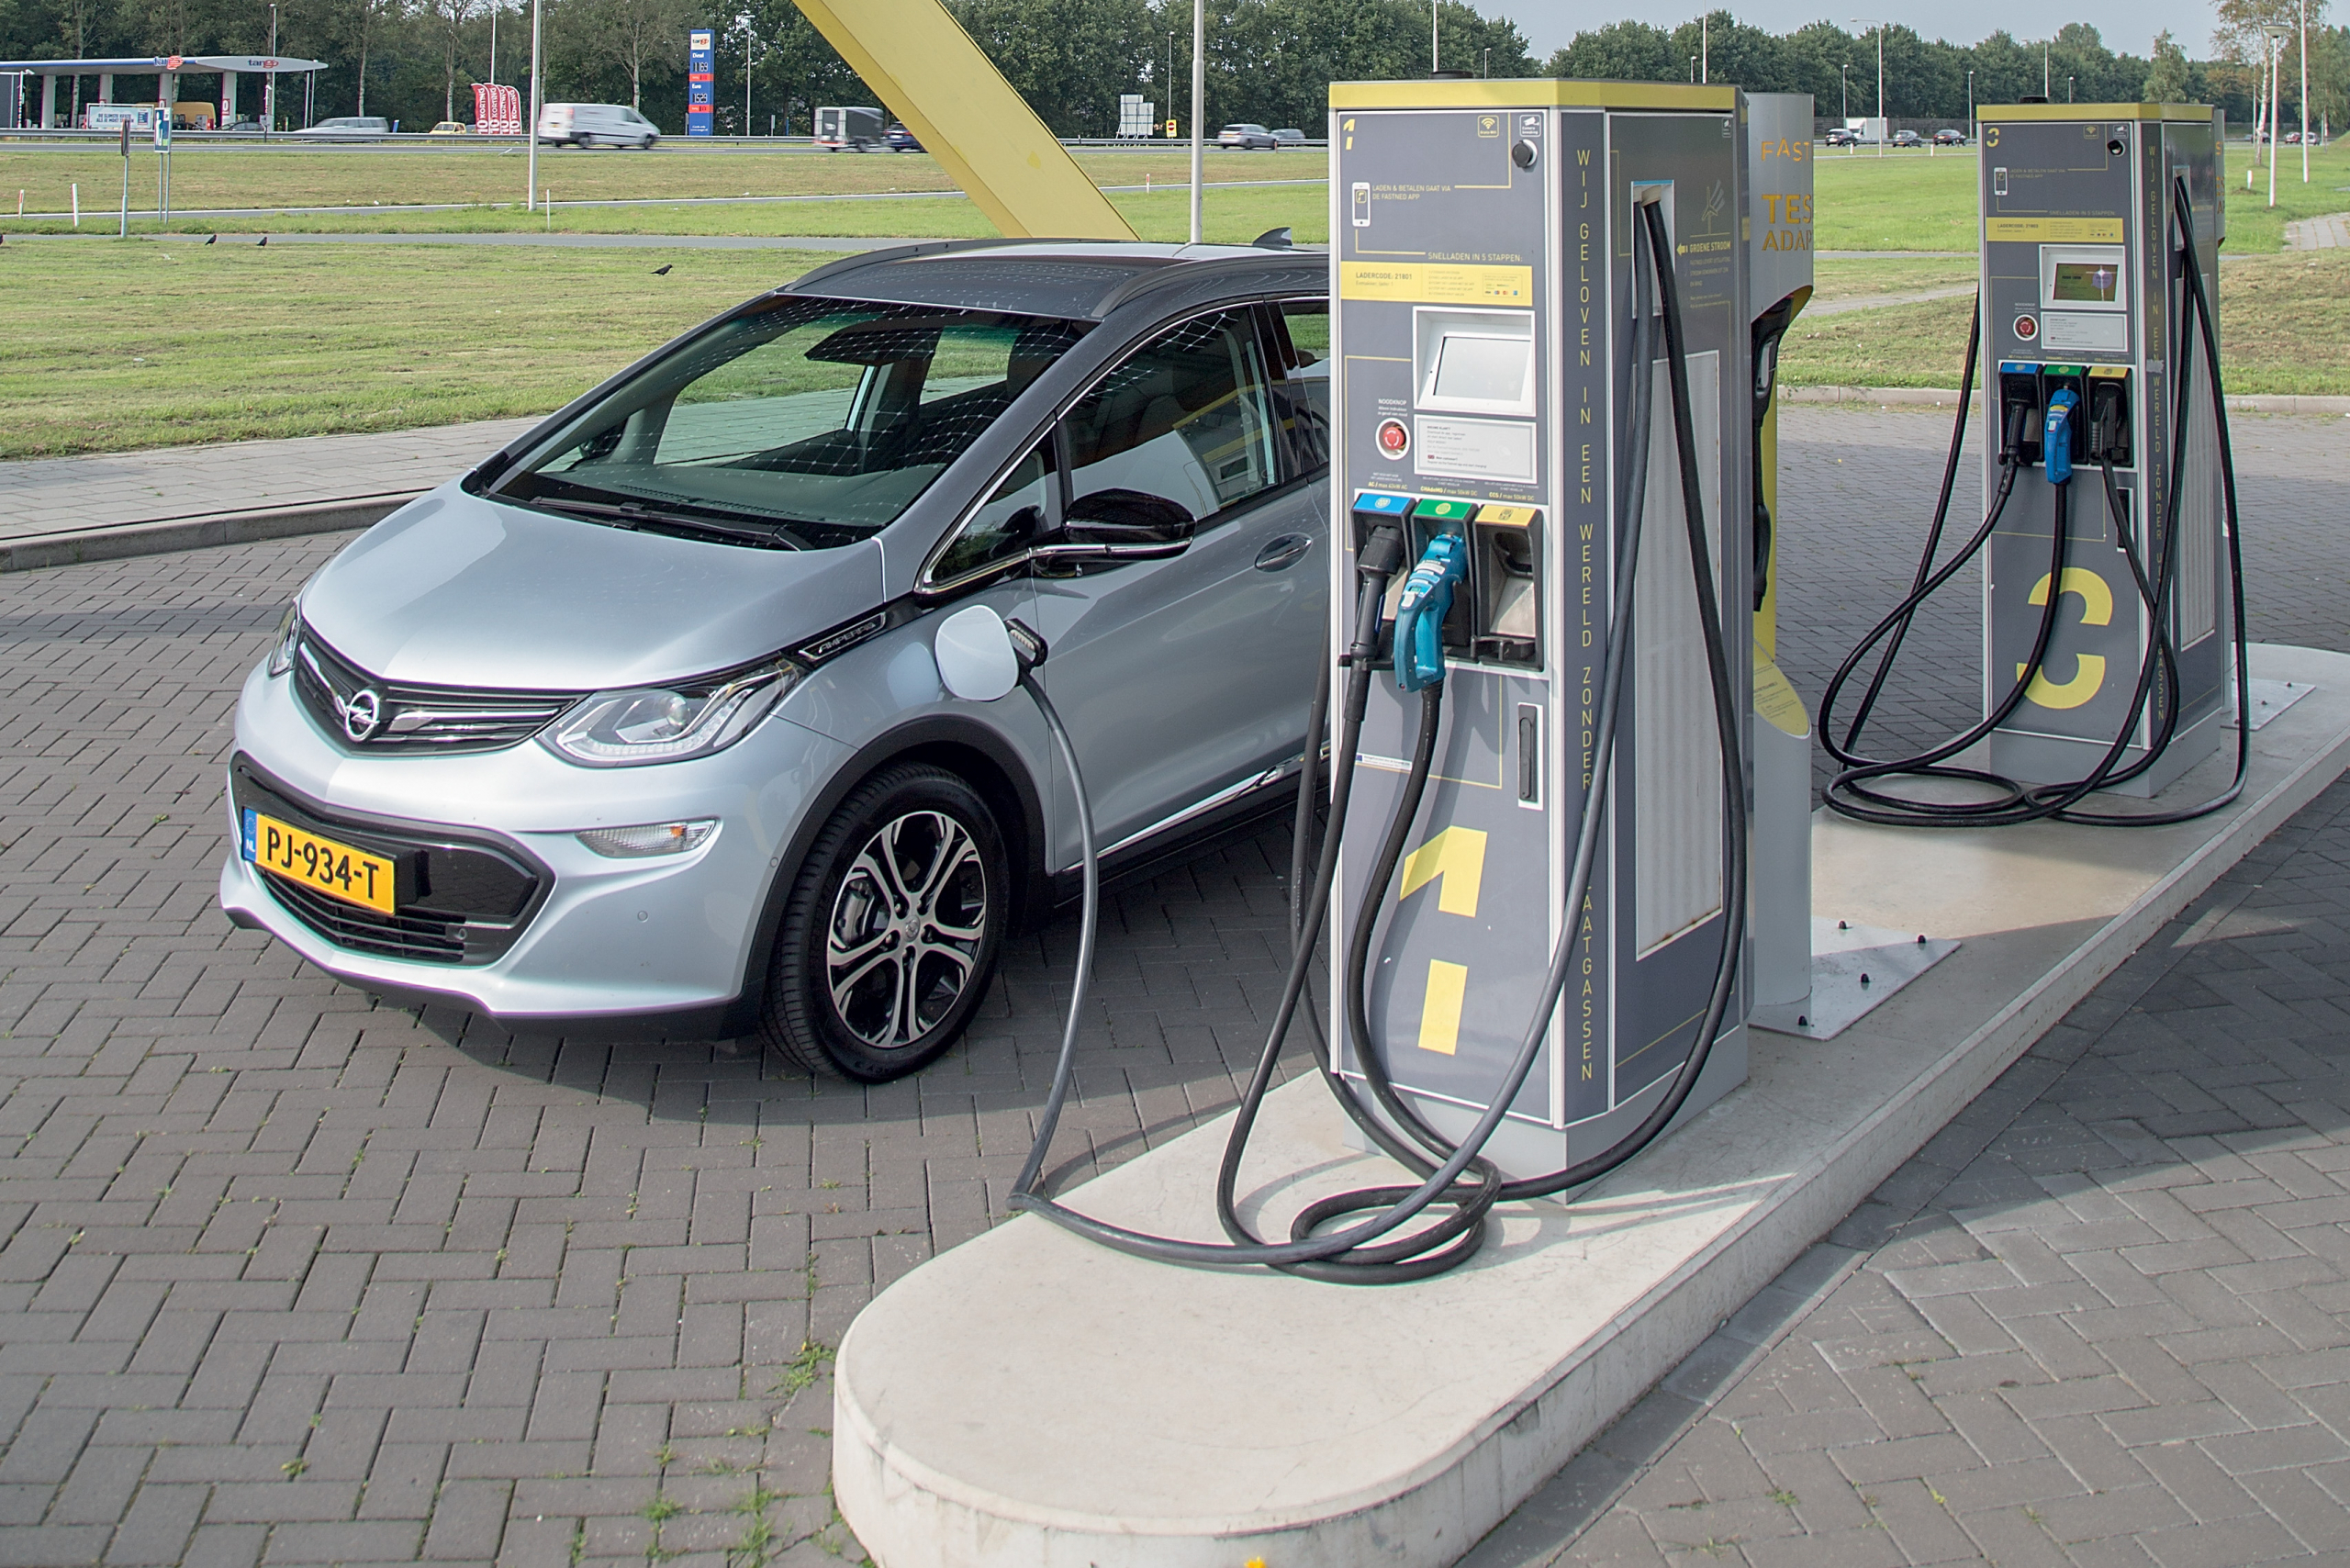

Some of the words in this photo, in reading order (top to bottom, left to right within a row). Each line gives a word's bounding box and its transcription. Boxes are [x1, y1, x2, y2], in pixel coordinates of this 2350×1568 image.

[248, 59, 279, 69] tango
[490, 87, 498, 118] KORTING
[1577, 149, 1591, 208] WIJ
[1427, 252, 1471, 261] SNELLADEN
[1472, 252, 1481, 261] IN
[1487, 253, 1523, 262] STAPPEN:
[1710, 241, 1731, 252] STROOM
[2150, 190, 2158, 279] GELOVEN
[1579, 223, 1591, 366] GELOVEN
[2152, 291, 2159, 315] IN
[1581, 386, 1591, 425] IN
[1581, 444, 1592, 504] EEN
[1579, 523, 1594, 647] WERELD
[2016, 566, 2113, 710] 3
[1582, 666, 1593, 790] ZONDER
[245, 838, 256, 854] NL
[266, 825, 380, 901] PJ-934-T
[1399, 824, 1488, 1056] 1
